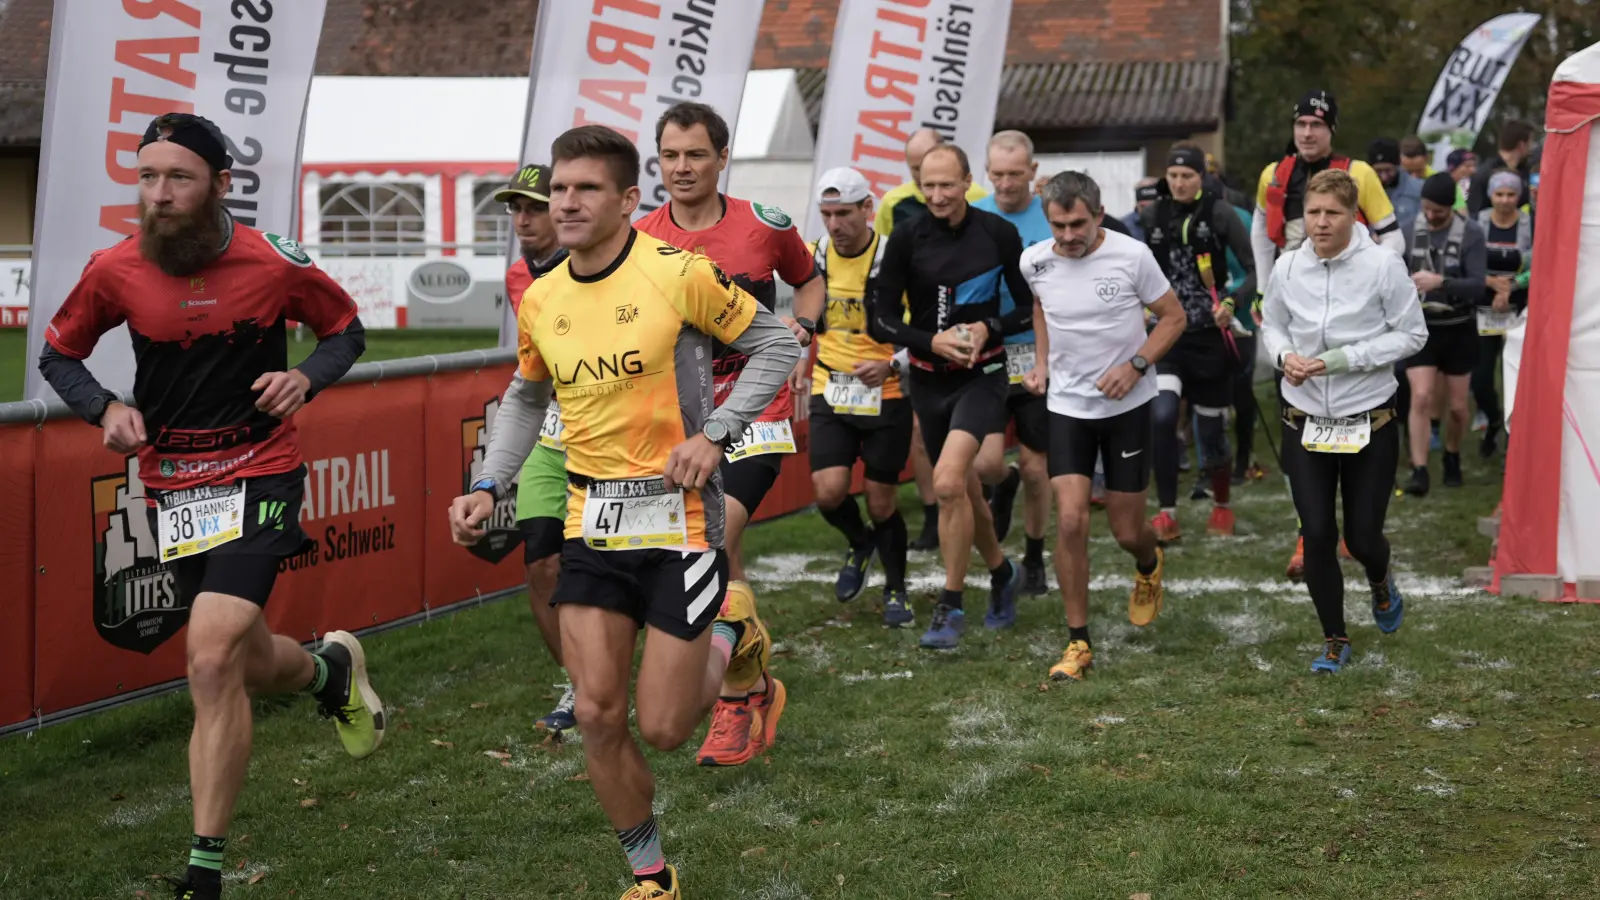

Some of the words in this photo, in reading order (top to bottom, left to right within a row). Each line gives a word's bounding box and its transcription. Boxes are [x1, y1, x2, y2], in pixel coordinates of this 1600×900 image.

[555, 350, 643, 385] LANG
[572, 381, 634, 400] HOLDING
[1313, 427, 1333, 443] 27
[195, 498, 237, 519] HANNES
[624, 499, 673, 510] SASCHA
[169, 507, 195, 543] 38
[595, 502, 625, 534] 47
[324, 516, 396, 563] Schweiz
